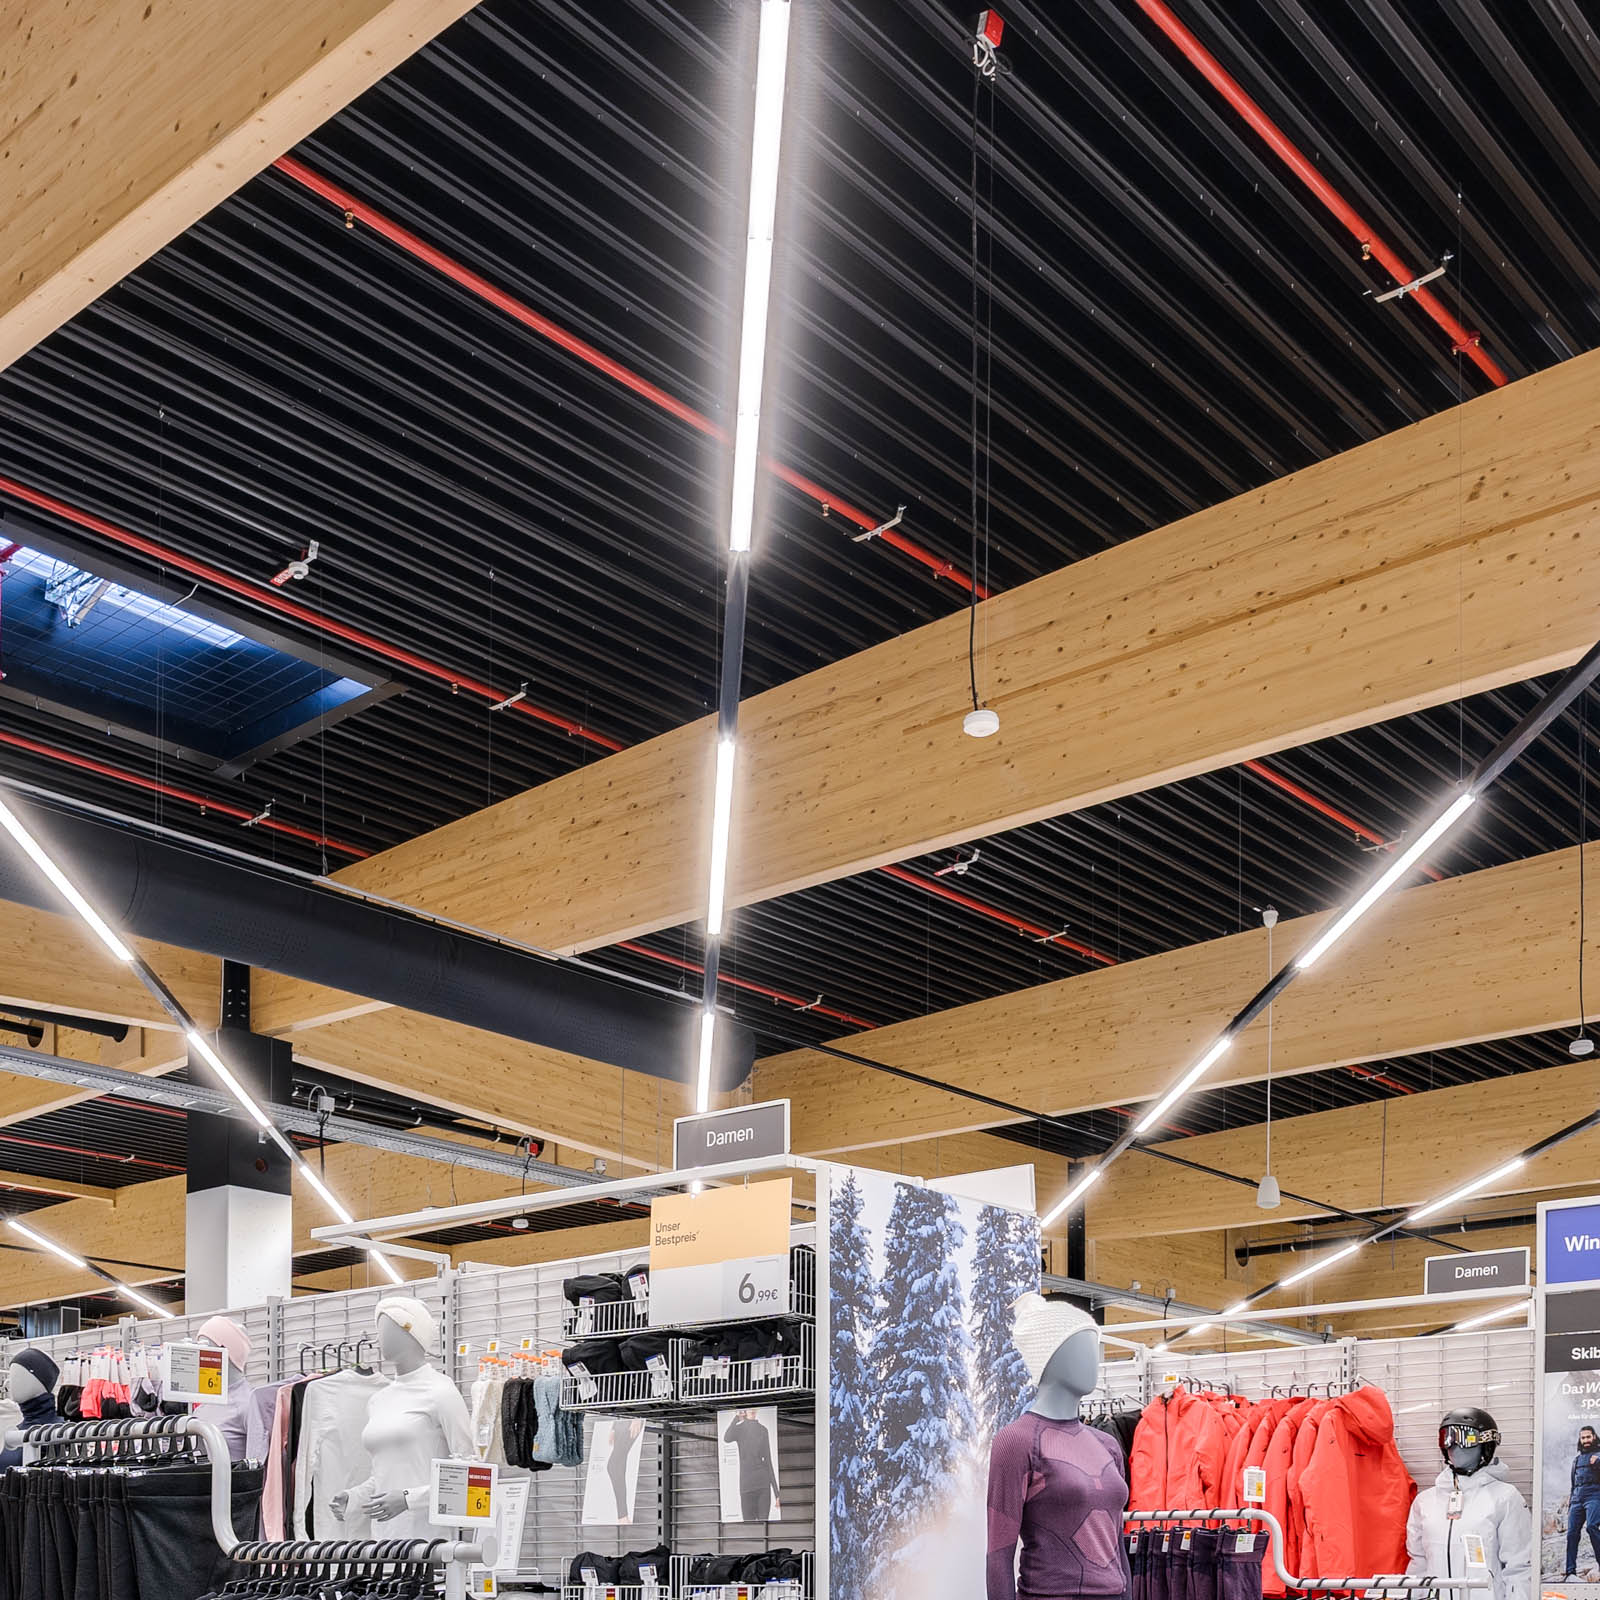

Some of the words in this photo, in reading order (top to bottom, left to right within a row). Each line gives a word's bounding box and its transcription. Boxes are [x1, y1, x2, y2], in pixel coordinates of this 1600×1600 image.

[706, 1127, 754, 1147] Damen
[655, 1223, 680, 1233] Unser
[655, 1232, 697, 1246] Bestpreis
[1455, 1265, 1499, 1279] Damen
[207, 1377, 214, 1388] 6
[1561, 1383, 1584, 1395] Das
[476, 1498, 482, 1510] 6
